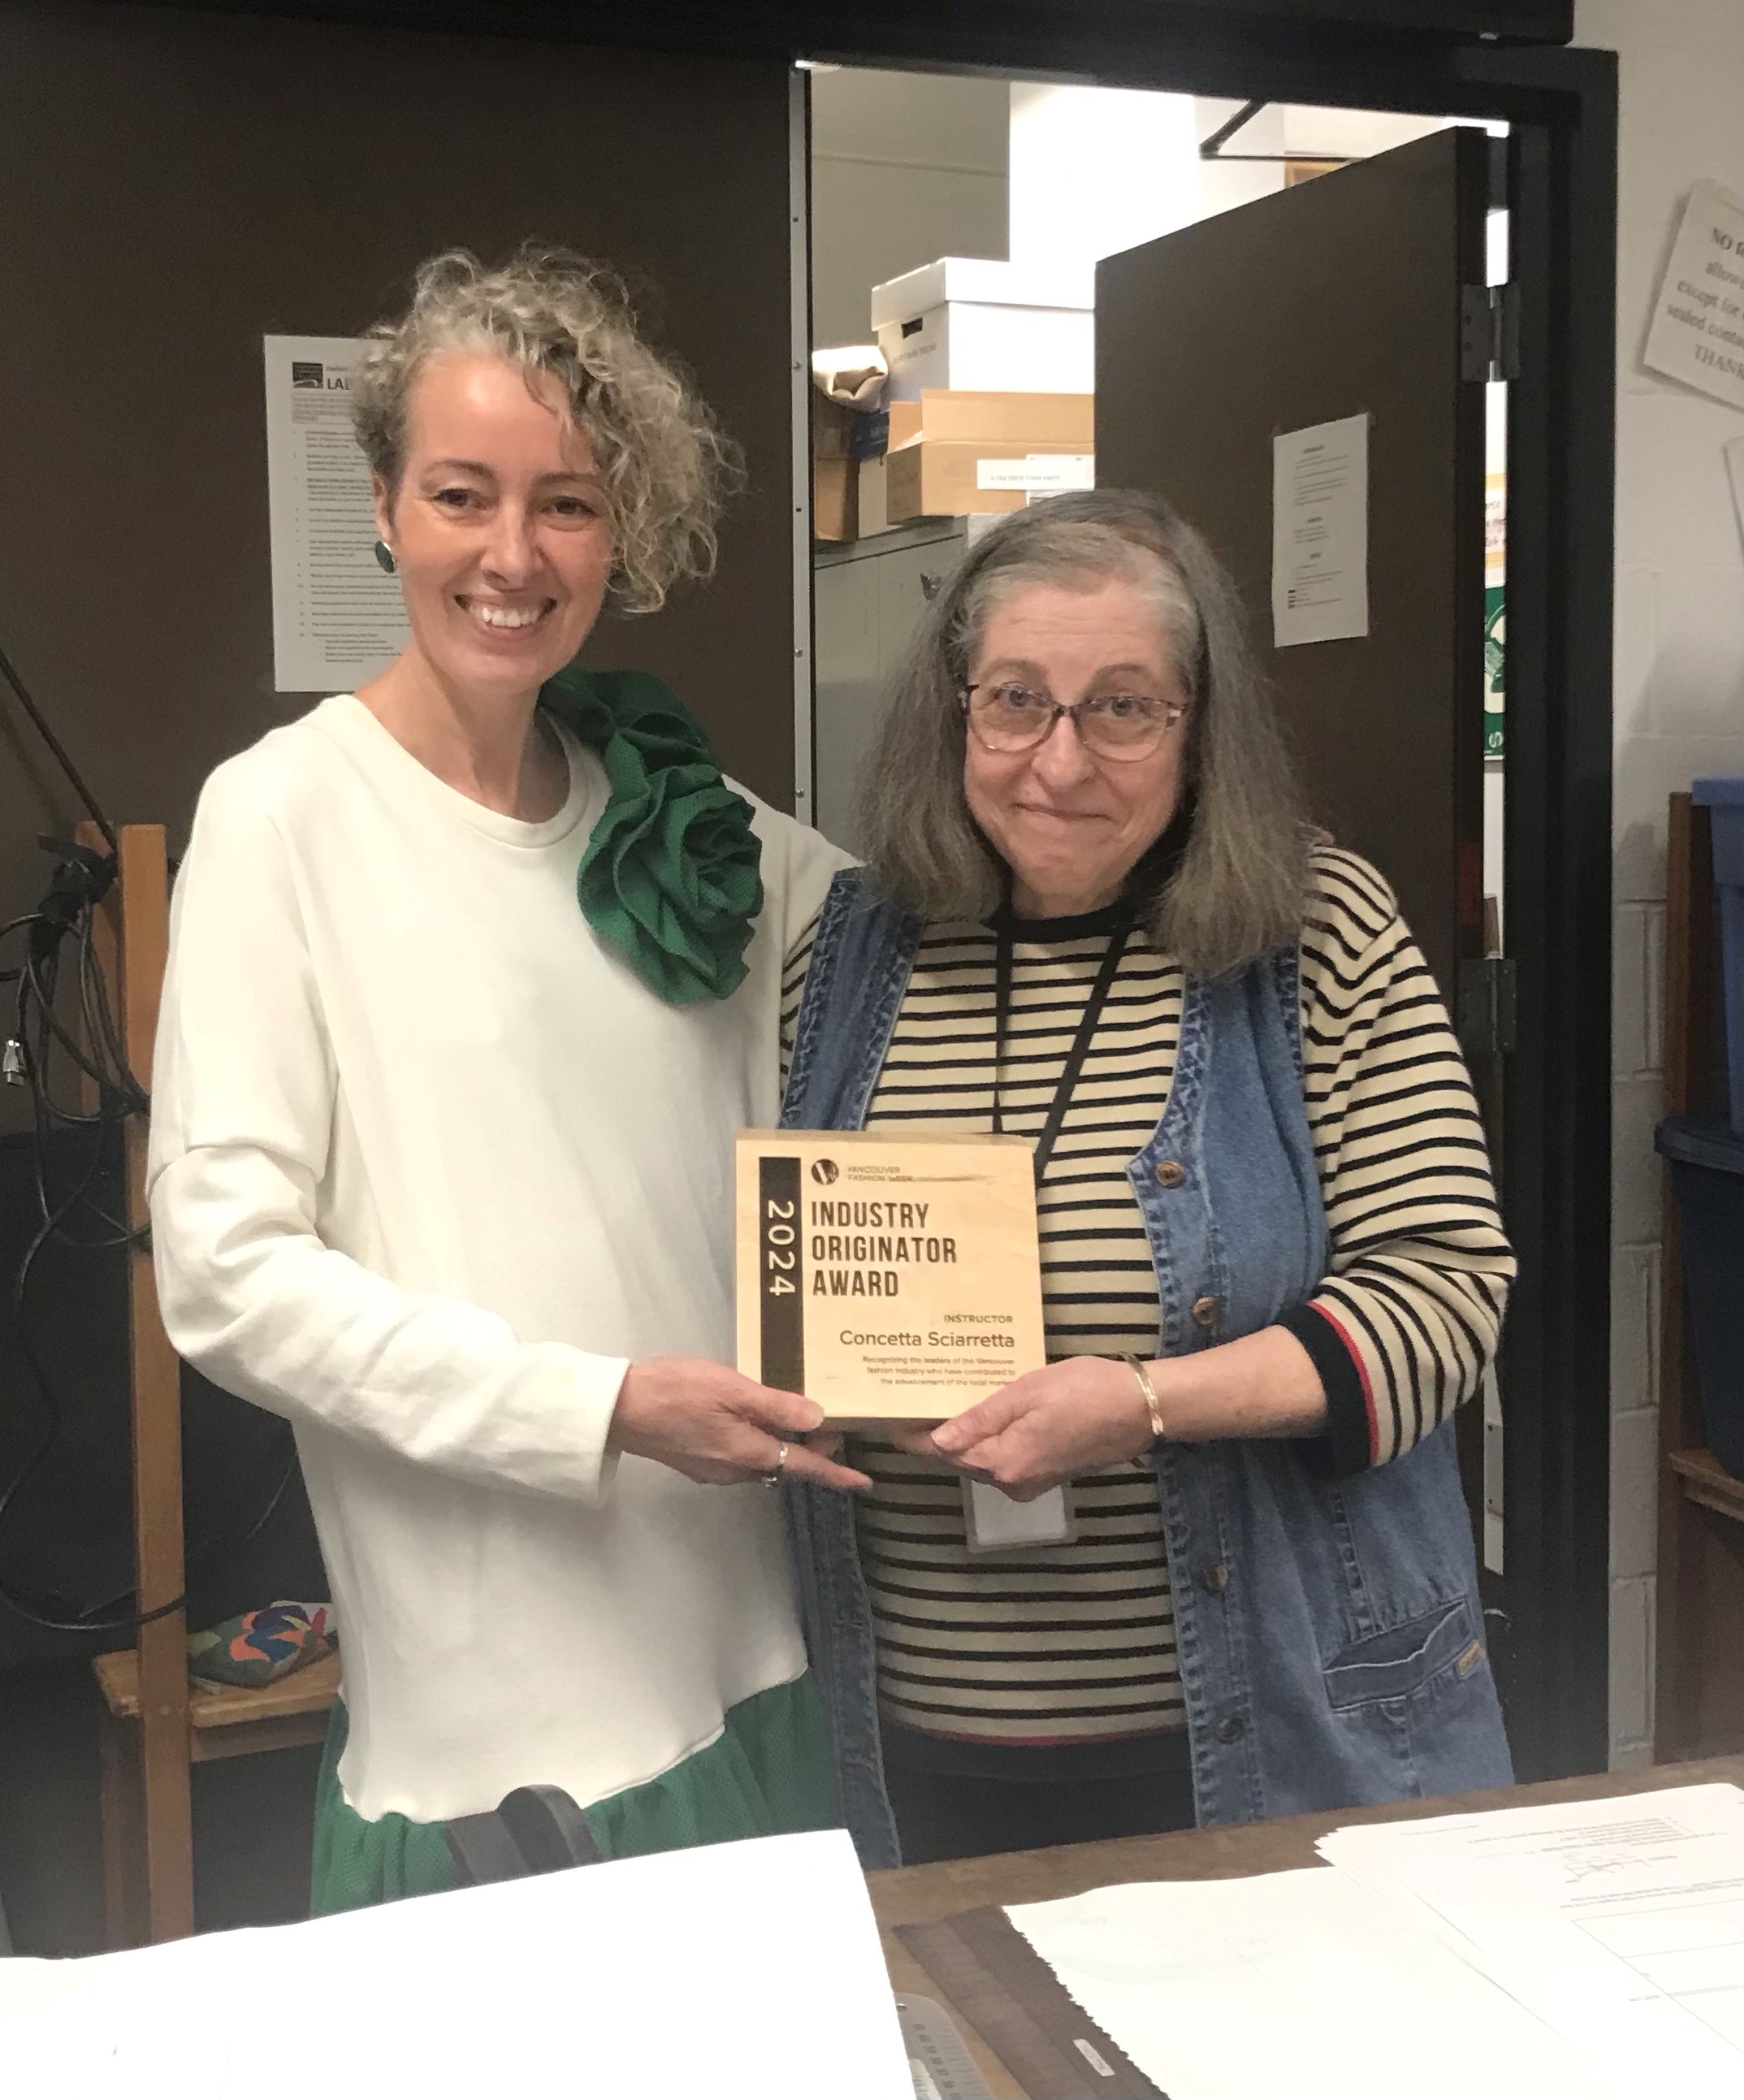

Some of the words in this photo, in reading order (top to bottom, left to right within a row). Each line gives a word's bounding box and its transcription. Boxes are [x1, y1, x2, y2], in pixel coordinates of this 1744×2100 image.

[847, 1165, 901, 1174] VANCOUVER
[847, 1174, 885, 1182] FASHION
[811, 1201, 929, 1229] INDUSTRY
[768, 1199, 795, 1297] 2024
[811, 1235, 958, 1263] ORIGINATOR
[812, 1270, 899, 1297] AWARD
[943, 1314, 1014, 1324] INSTRUCTOR
[839, 1330, 922, 1347] Concetta
[927, 1331, 1015, 1348] Sciarretta
[862, 1355, 908, 1365] Recognizing
